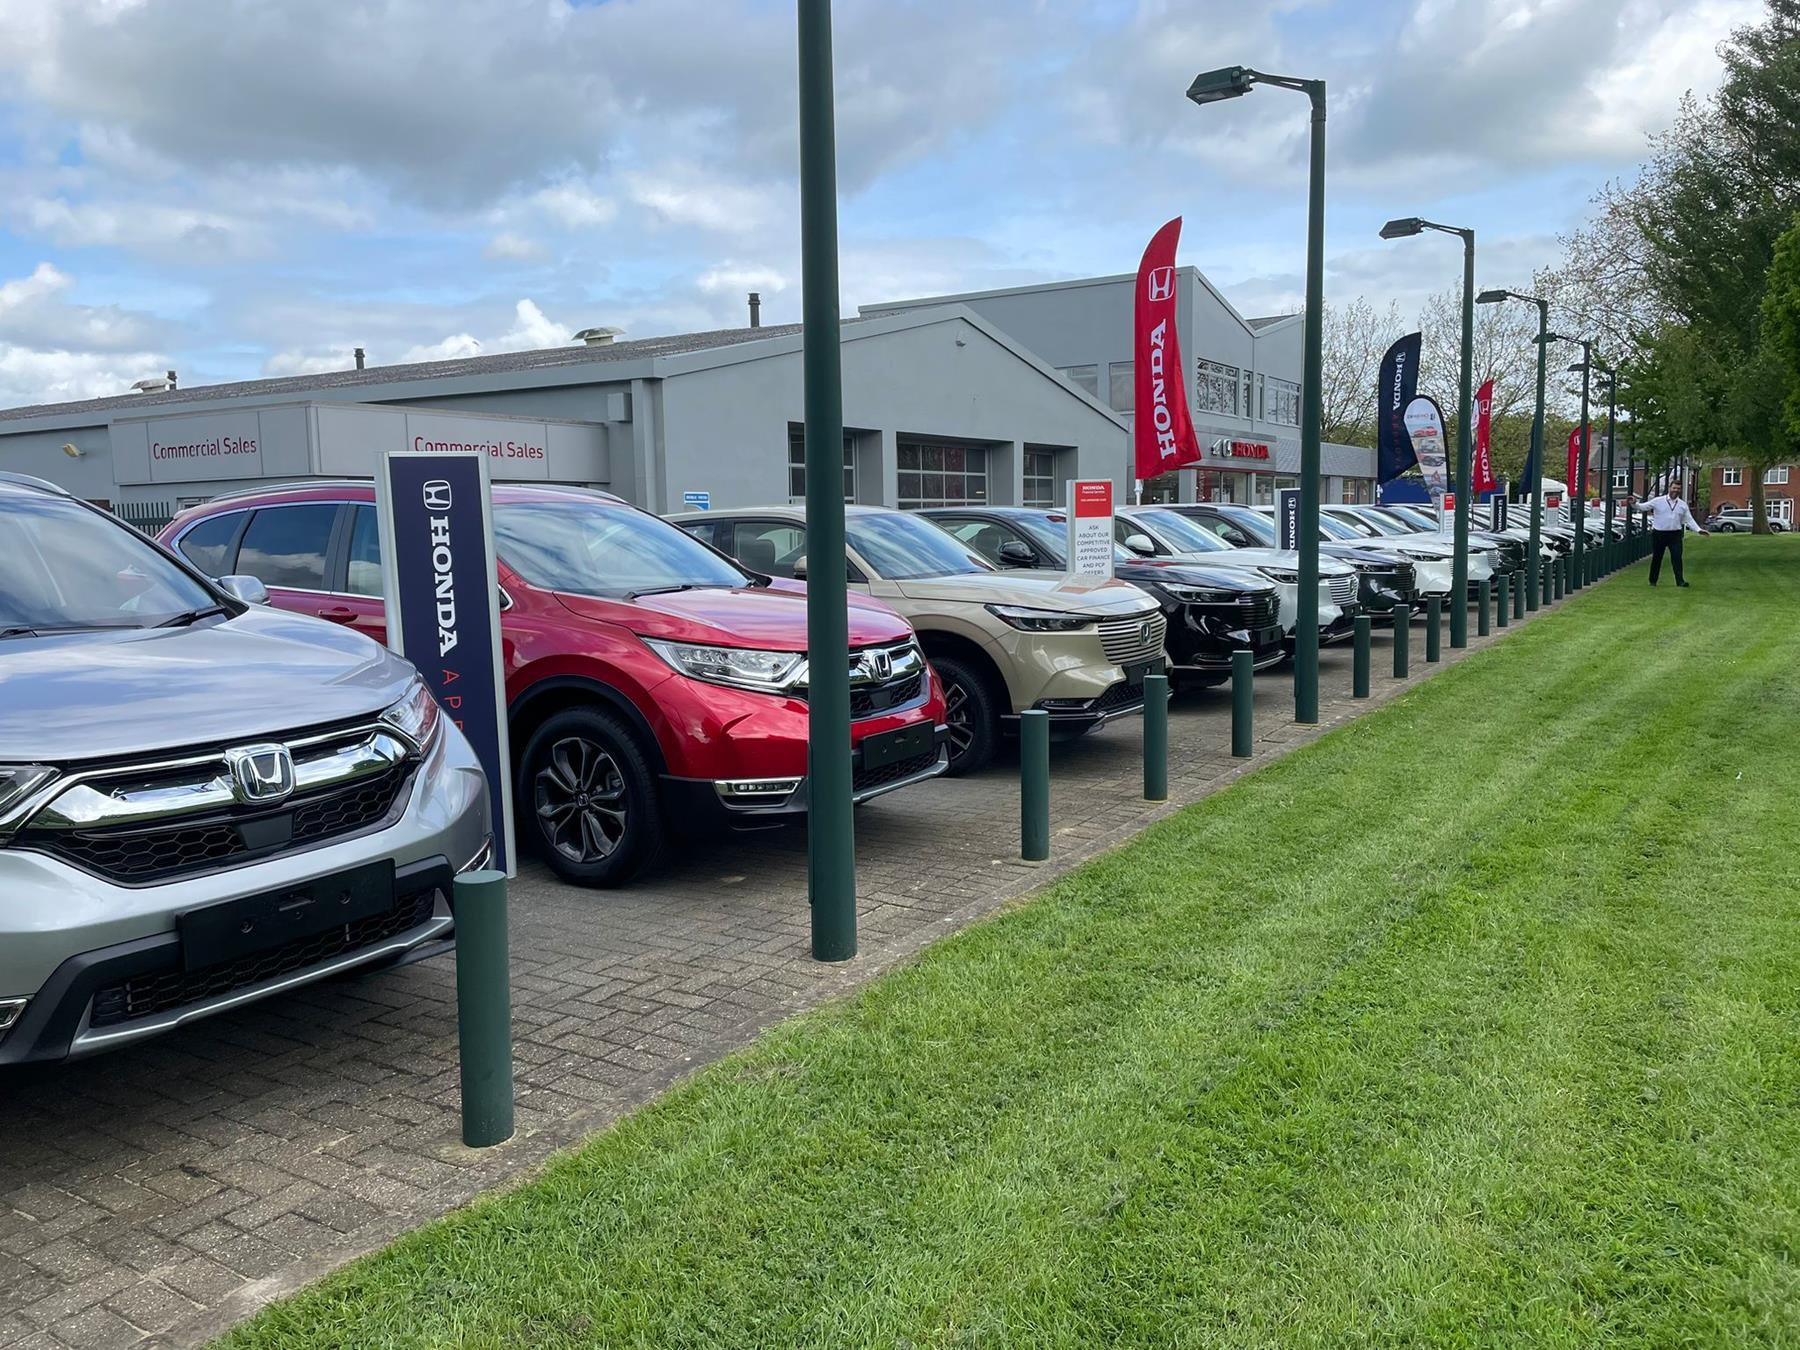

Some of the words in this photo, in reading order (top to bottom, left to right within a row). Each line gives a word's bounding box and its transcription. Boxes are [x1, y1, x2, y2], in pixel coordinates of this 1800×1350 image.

[1151, 318, 1176, 460] HONDA
[1393, 364, 1403, 410] HONDA
[153, 438, 221, 460] Commercial
[223, 437, 257, 455] Sales
[507, 442, 544, 459] Sales
[1234, 441, 1270, 459] HONDA
[430, 516, 458, 657] HONDA
